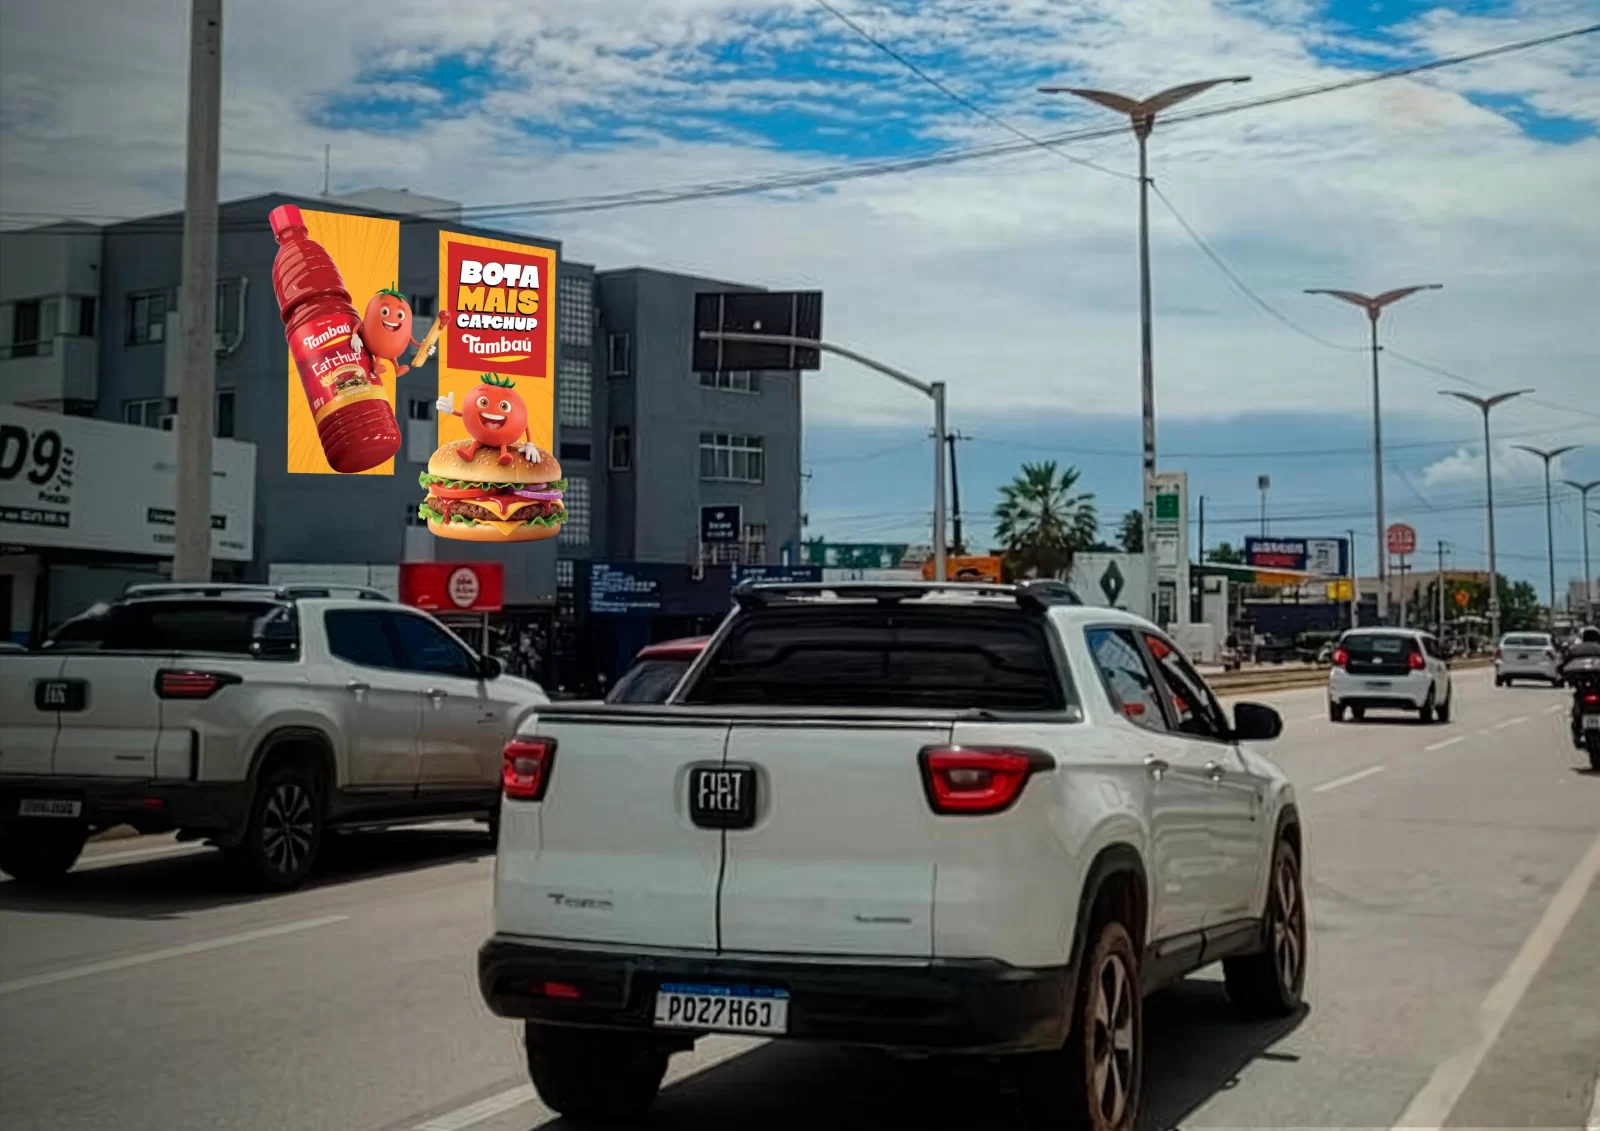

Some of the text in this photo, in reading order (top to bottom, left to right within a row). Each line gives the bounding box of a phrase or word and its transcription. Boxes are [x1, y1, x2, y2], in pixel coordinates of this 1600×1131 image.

[460, 260, 540, 289] BOTA
[456, 285, 540, 316] MAIS
[303, 322, 352, 350] Tambaú
[456, 313, 538, 332] CATCHUP
[461, 333, 532, 354] Tambaú
[311, 351, 362, 377] Catchup
[0, 424, 62, 485] D9
[698, 771, 743, 811] FIAT
